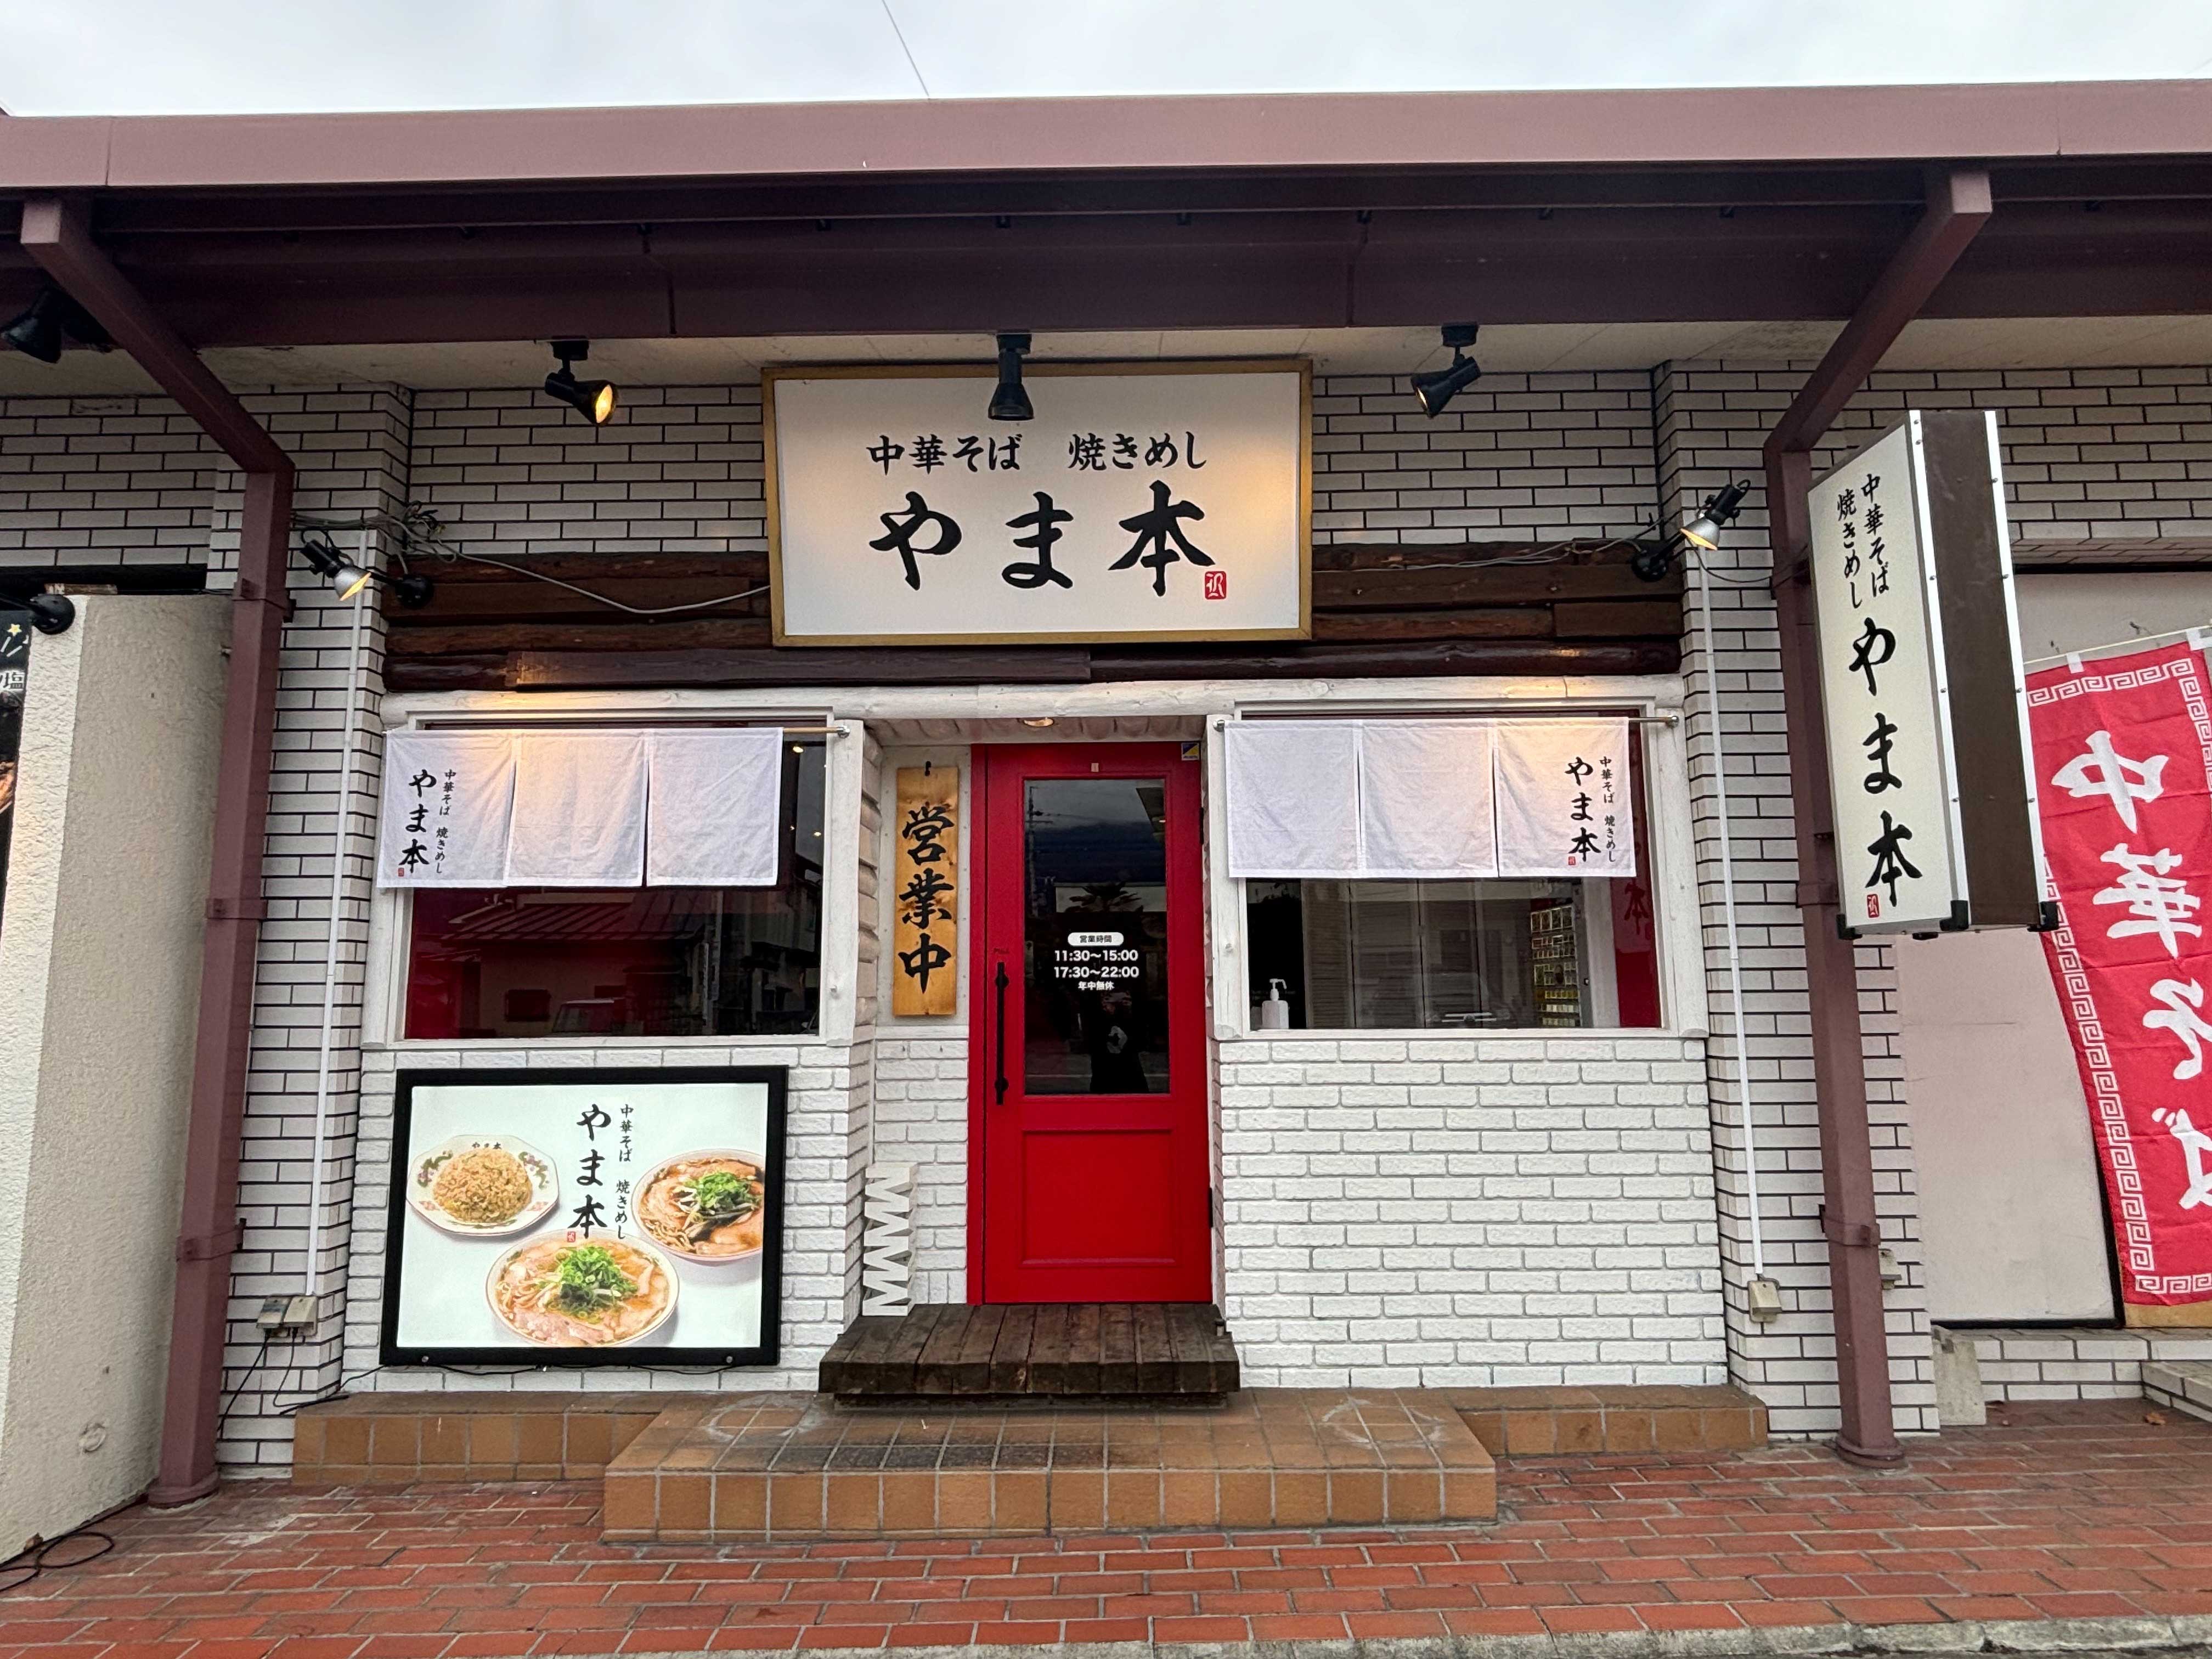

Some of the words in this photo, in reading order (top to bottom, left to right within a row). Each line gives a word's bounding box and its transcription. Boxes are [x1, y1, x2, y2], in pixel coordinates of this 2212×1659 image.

[866, 434, 1023, 475] 中華そば
[1068, 431, 1207, 472] 焼きめし
[869, 479, 1216, 597] やま本
[1837, 488, 1863, 608] 焼きめし
[1861, 473, 1889, 597] 中華そば
[1599, 756, 1615, 804] 中華そば
[1849, 617, 1922, 907] やま本
[398, 769, 437, 873] やま本
[439, 769, 456, 816] 中華そば
[1565, 756, 1601, 862] やま本
[435, 826, 449, 874] 焼きめし
[1604, 815, 1616, 863] 焼きめし
[898, 805, 955, 994] 営業中
[1080, 935, 1113, 943] 営業時間
[1077, 981, 1115, 991] 年中無休
[619, 1104, 634, 1162] 中華そば
[567, 1103, 612, 1239] やま本
[614, 1180, 630, 1239] 焼きめし
